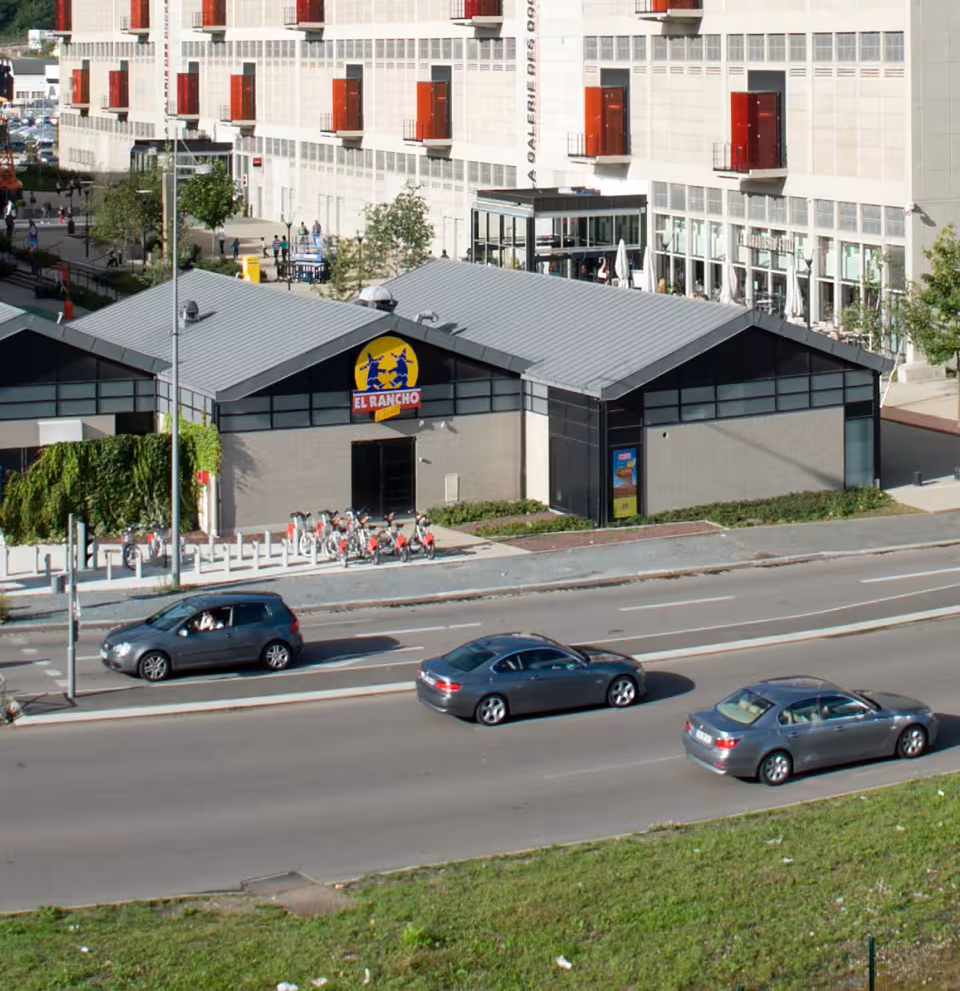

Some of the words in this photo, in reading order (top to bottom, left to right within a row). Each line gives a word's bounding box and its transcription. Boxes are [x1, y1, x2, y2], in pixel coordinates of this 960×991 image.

[527, 38, 536, 76] DES
[527, 81, 536, 164] GALERIE
[354, 396, 368, 409] EL
[370, 392, 419, 407] RANCHO
